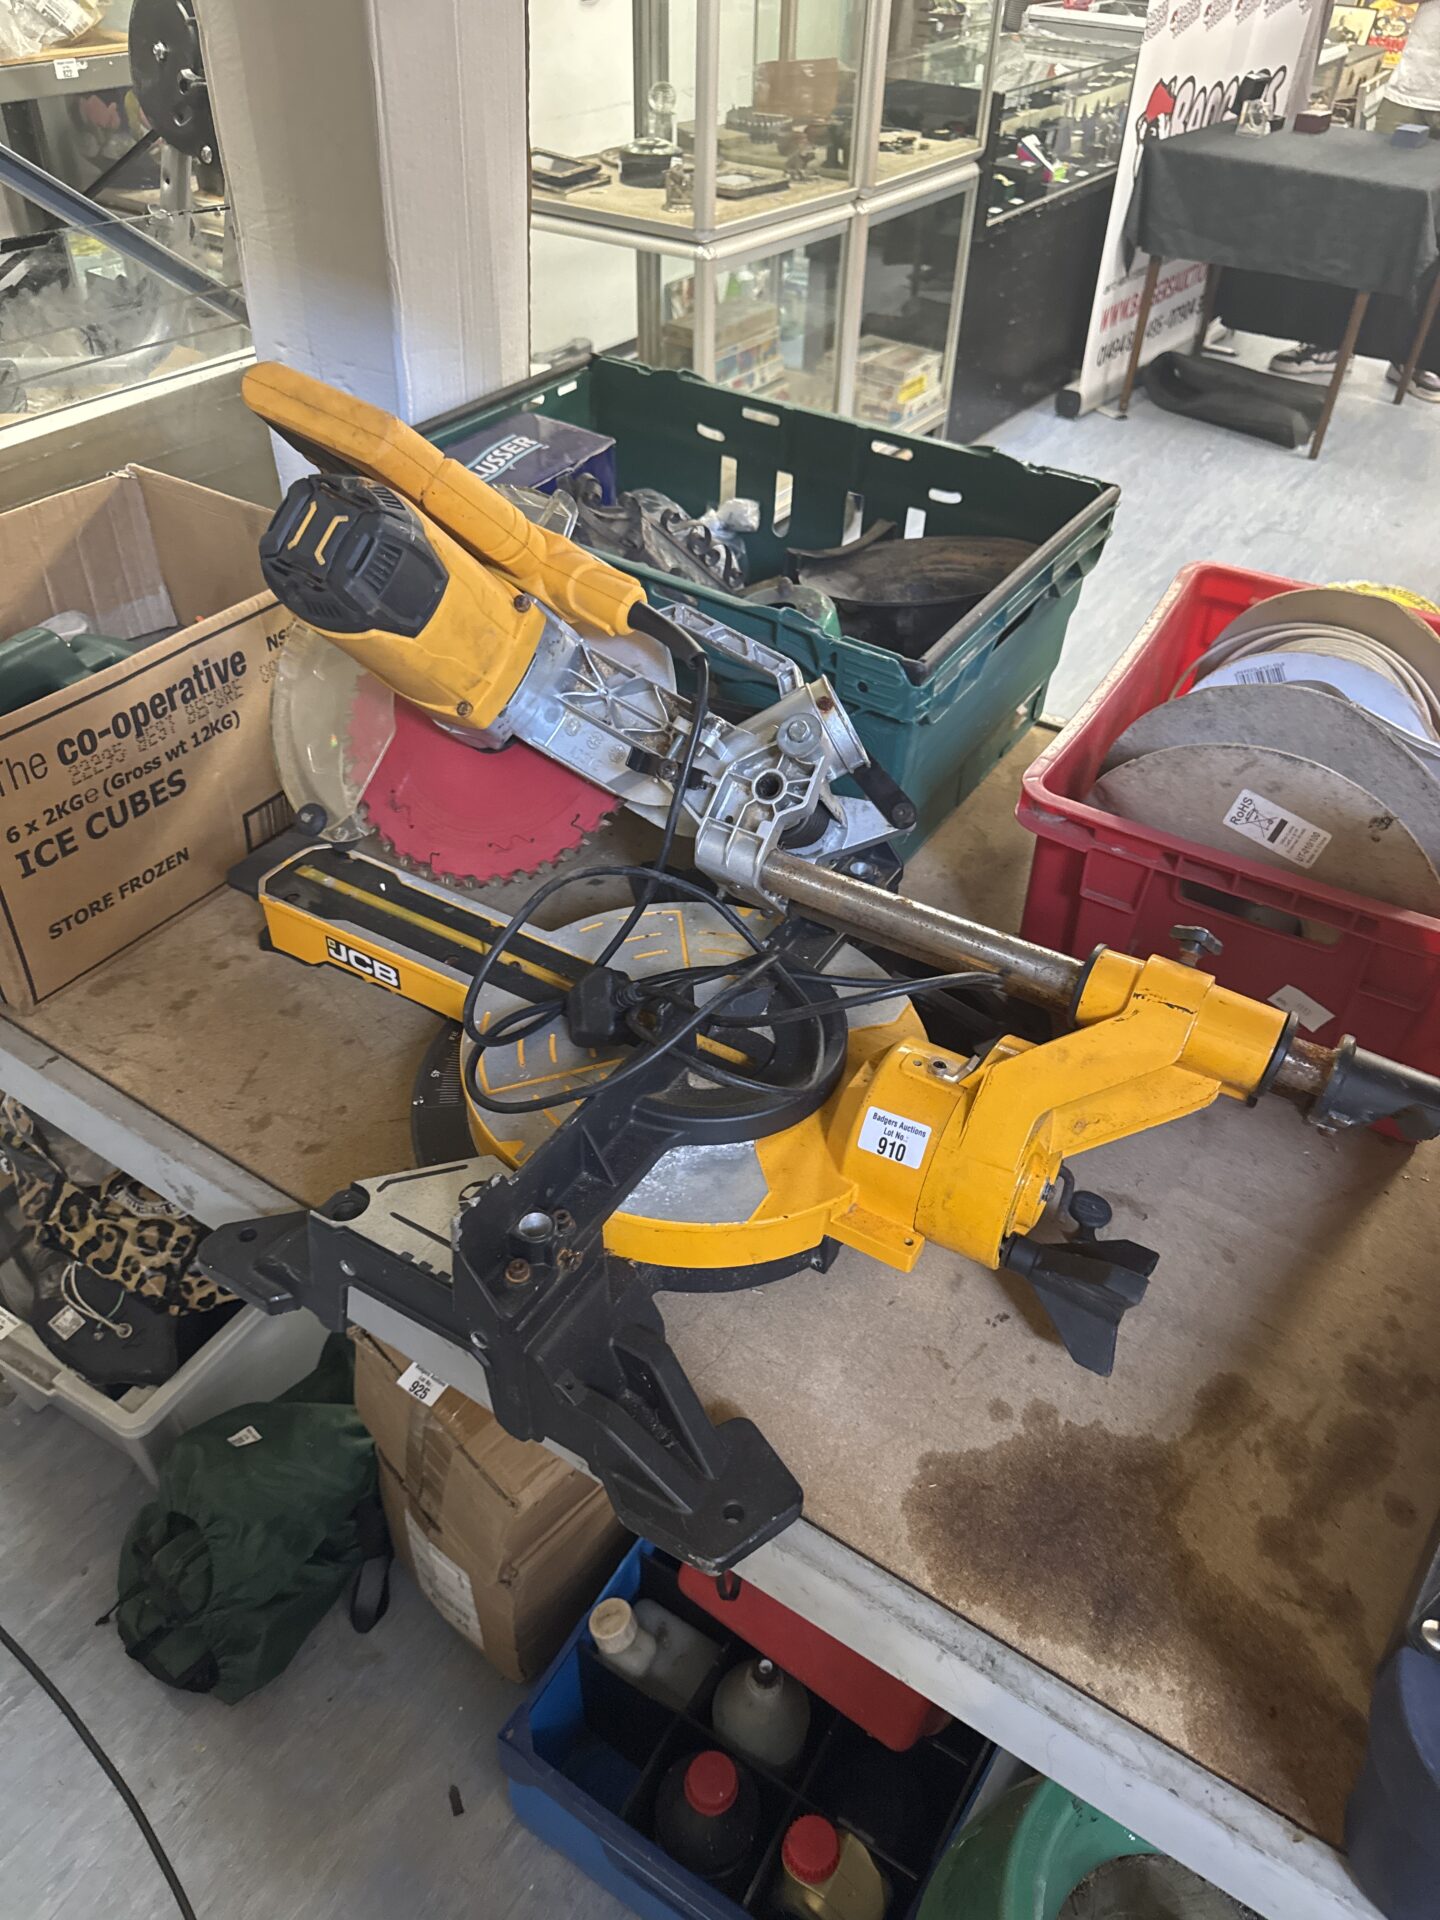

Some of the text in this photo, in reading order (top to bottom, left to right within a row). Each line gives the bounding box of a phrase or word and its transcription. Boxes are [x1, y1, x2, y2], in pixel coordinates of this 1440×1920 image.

[57, 651, 247, 766] co-operative
[135, 714, 176, 752] BEST
[184, 679, 244, 725] BEFORE
[6, 825, 21, 844] 6
[24, 819, 40, 836] x
[103, 755, 162, 798] (Gross
[165, 739, 189, 762] wt
[190, 709, 241, 749] 12KG)
[14, 768, 188, 880] ICE CUBES
[1229, 796, 1253, 825] RoHS
[48, 847, 190, 940] STORE FROZEN
[328, 939, 399, 987] JCB
[872, 1112, 927, 1138] Badgers Auctions
[877, 1136, 906, 1162] 910
[883, 1127, 894, 1137] Lot
[408, 1380, 430, 1400] 925
